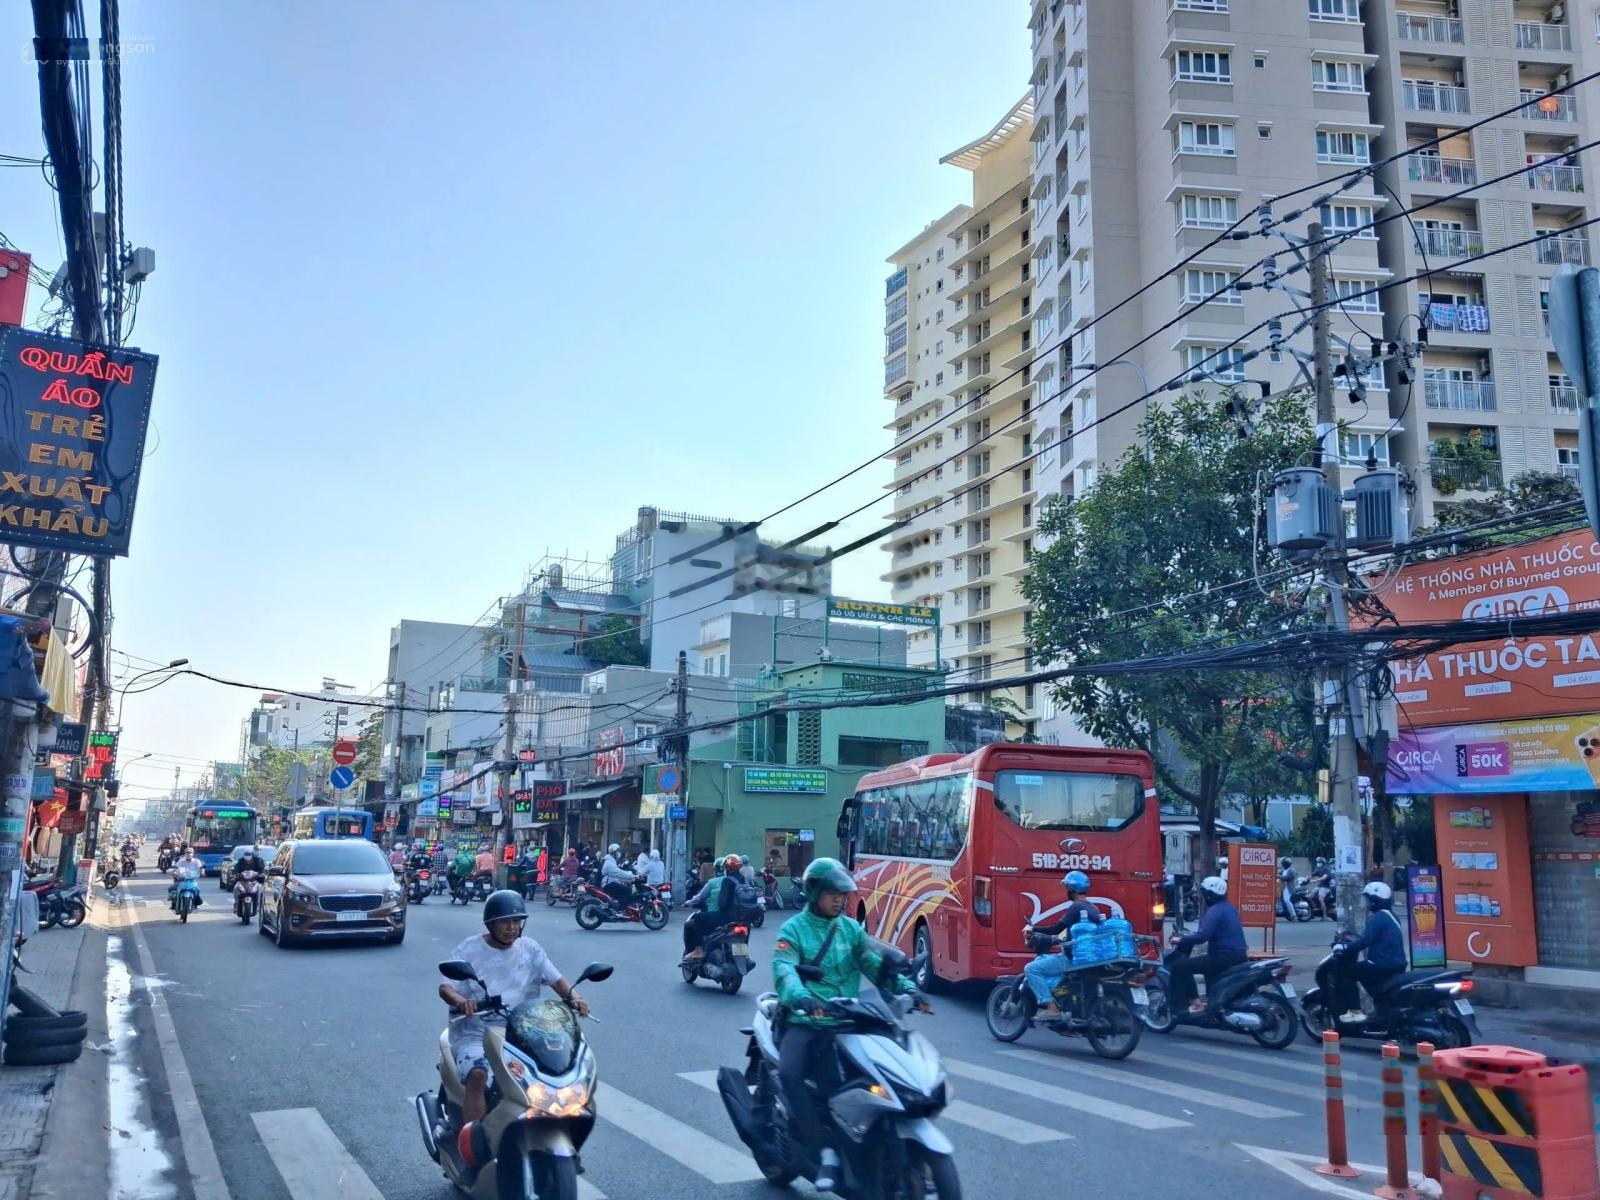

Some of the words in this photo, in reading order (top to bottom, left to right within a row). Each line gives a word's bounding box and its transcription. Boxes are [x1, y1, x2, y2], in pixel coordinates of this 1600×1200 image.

[41, 379, 101, 408] ÁO
[25, 410, 108, 442] TRẺ
[29, 443, 94, 471] EM
[0, 471, 112, 505] XUẤT
[1395, 581, 1413, 594] HỆ
[1419, 567, 1475, 589] THỐNG
[1480, 556, 1516, 578] NHÀ
[1522, 542, 1585, 569] THUỐC
[1429, 592, 1436, 601] A
[1439, 582, 1487, 599] Member
[1490, 578, 1504, 589] Of
[1507, 568, 1560, 590] Buymed
[1396, 750, 1443, 765] CIRCA
[1471, 754, 1504, 769] 50K
[1243, 851, 1272, 862] CIRCA
